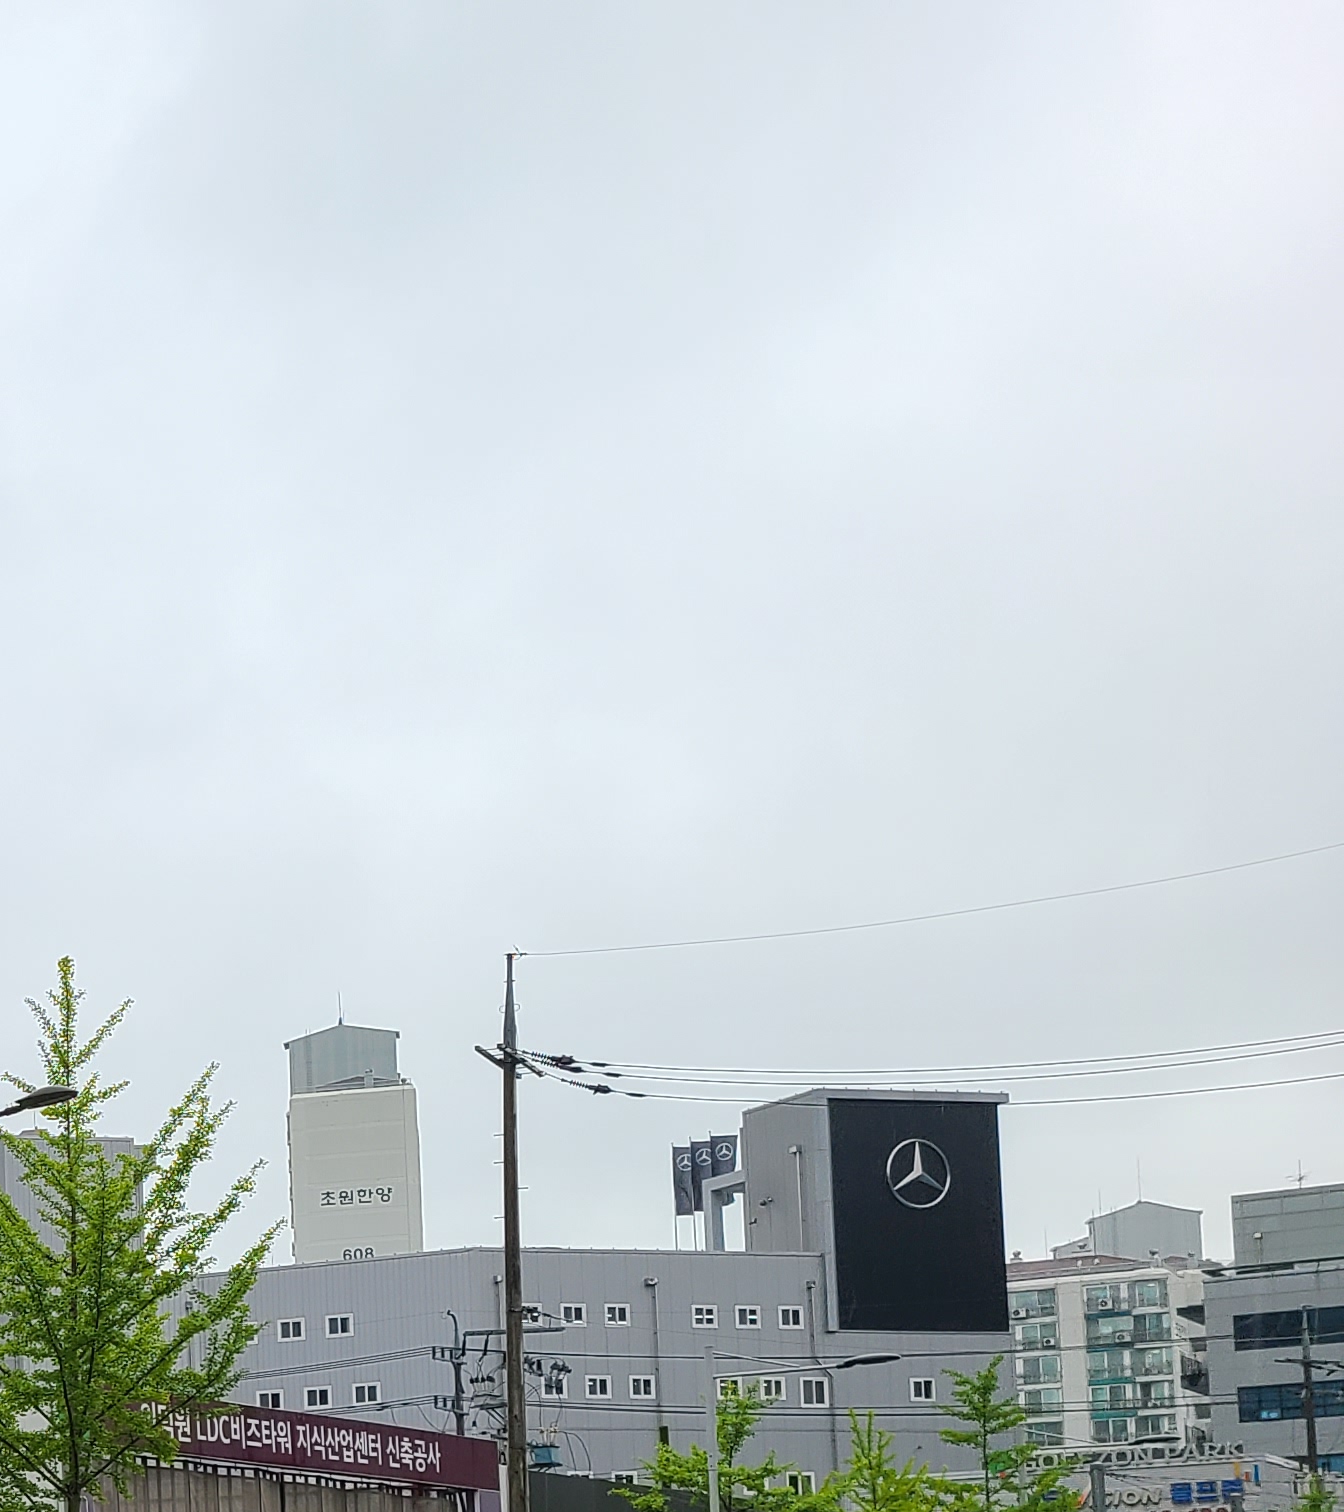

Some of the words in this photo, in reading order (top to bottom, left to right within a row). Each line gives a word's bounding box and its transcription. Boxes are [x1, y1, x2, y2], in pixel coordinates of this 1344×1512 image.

[321, 1187, 392, 1206] 초원한양
[343, 1247, 374, 1261] 608
[196, 1411, 293, 1455] LDC비즈타워
[297, 1425, 381, 1465] 지식산업센터
[386, 1436, 441, 1473] 신축공사
[1024, 1447, 1153, 1471] GOZON
[1163, 1441, 1245, 1463] PARK
